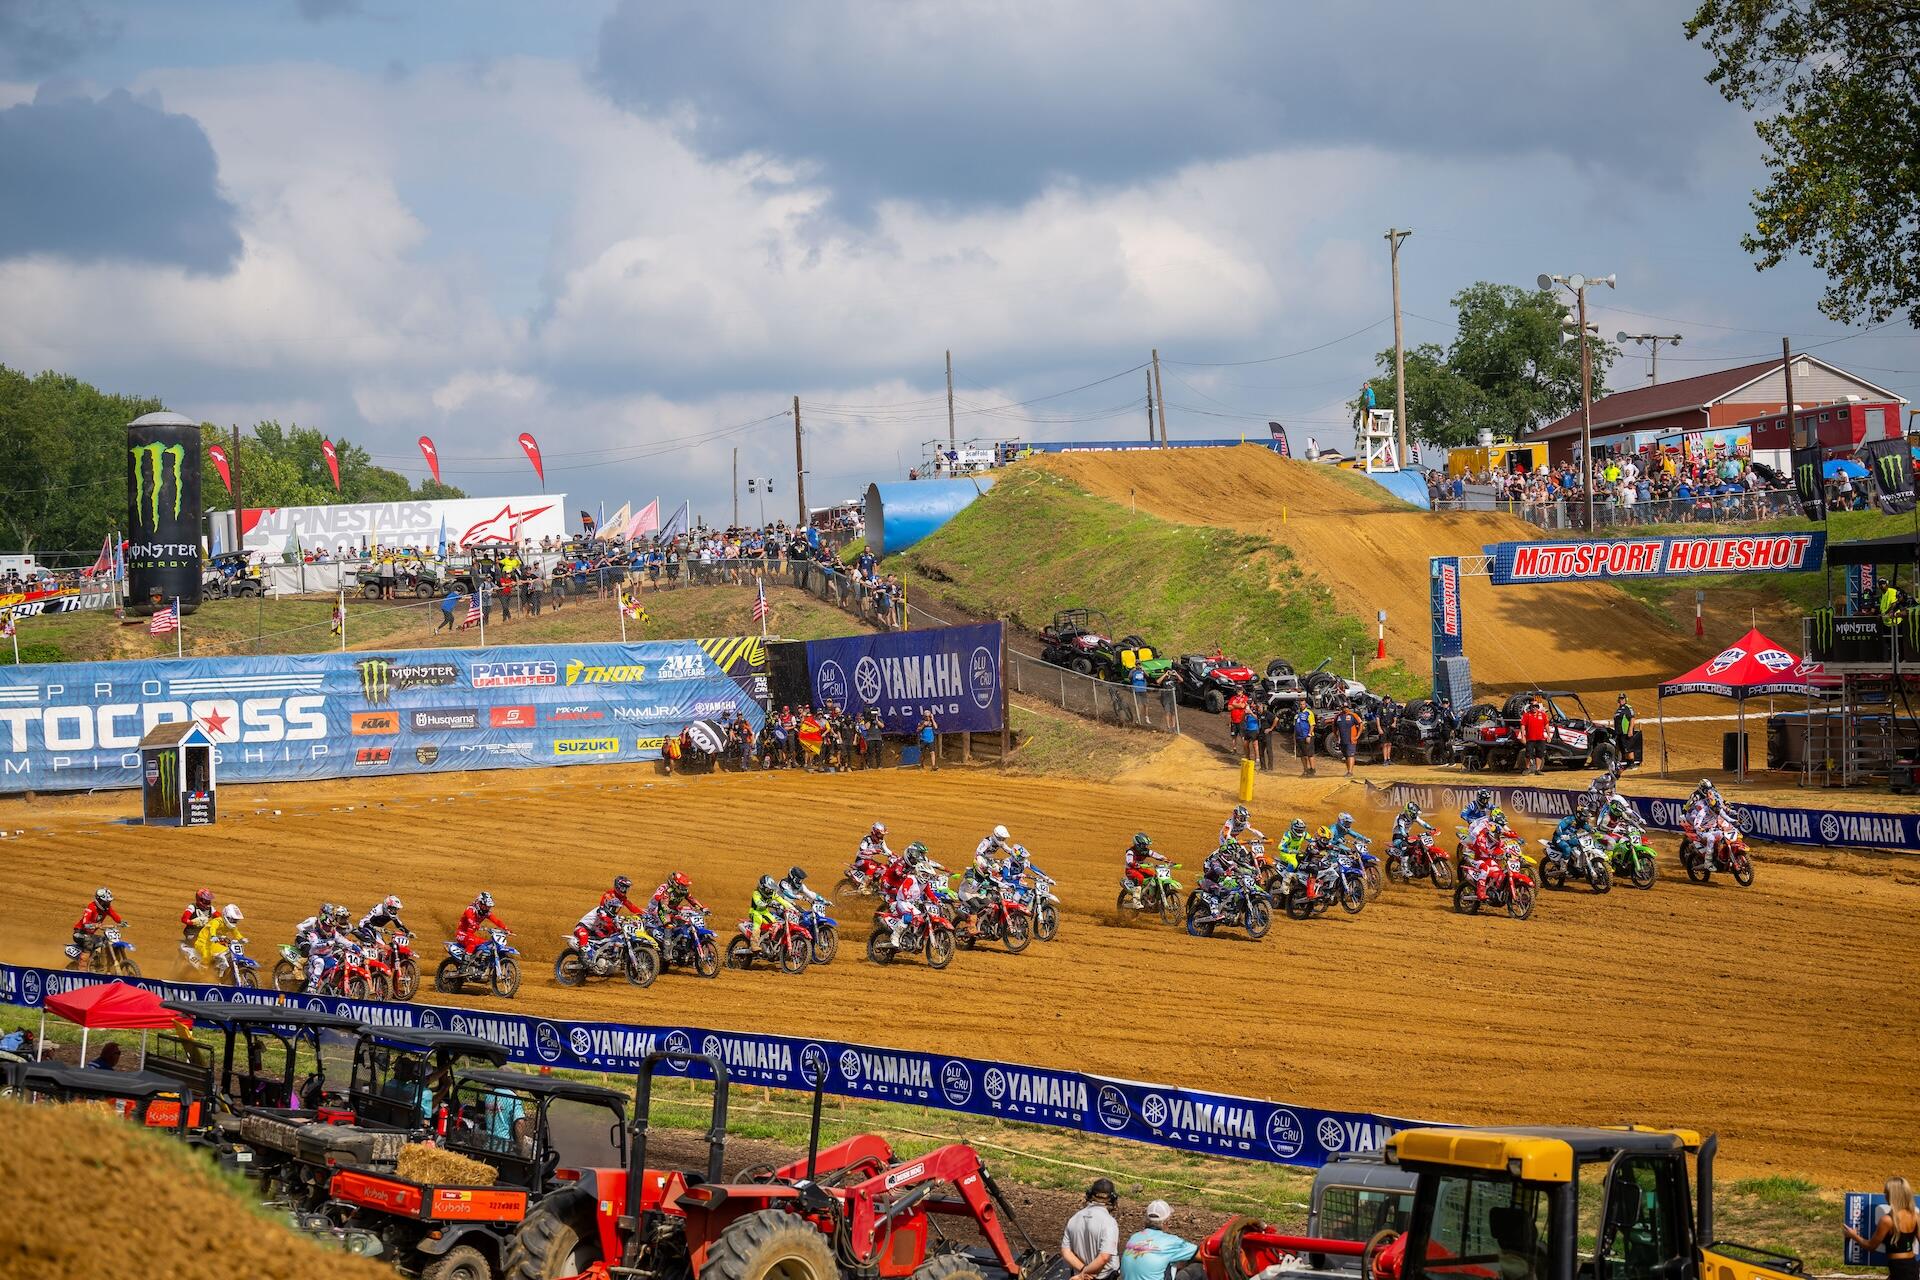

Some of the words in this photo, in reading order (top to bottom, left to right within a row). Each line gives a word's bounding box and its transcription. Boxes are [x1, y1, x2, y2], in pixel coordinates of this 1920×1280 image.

[256, 503, 433, 536] ALPINESTARS
[1667, 537, 1811, 572] HOLESHOT
[1836, 622, 1877, 633] MONSTER
[472, 662, 557, 679] PARTS
[658, 654, 704, 671] AMA
[392, 665, 455, 679] MONSTER
[584, 665, 646, 684] THOR
[659, 670, 673, 679] 100
[684, 668, 706, 677] YEARS
[880, 652, 964, 700] YAMAHA
[473, 675, 557, 687] UNLIMITED
[47, 680, 162, 700] PRO
[614, 704, 680, 718] NAMURA
[704, 700, 737, 712] YAMAHA
[361, 718, 391, 729] KTM
[427, 714, 474, 726] Husqvarna
[558, 740, 614, 752] SUZUKI
[1455, 789, 1501, 809] YAMHA
[1525, 791, 1574, 815] YAMAHA
[1751, 810, 1811, 838] YAMAHA
[1839, 815, 1906, 843] YAMAHA
[1727, 831, 1736, 840] 7
[467, 1017, 529, 1048] YAMAHA
[590, 1030, 656, 1058] YAMAHA
[579, 1056, 640, 1067] RACIN
[722, 1038, 793, 1072] YAMAHA
[710, 1067, 787, 1082] ACING
[861, 1053, 934, 1089] YAMAHA
[848, 1081, 929, 1099] RACING
[1007, 1072, 1088, 1112] YAMAHA
[150, 1111, 178, 1121] Kubot
[992, 1100, 1082, 1121] RACING
[1168, 1098, 1257, 1140] YAMAHA
[1152, 1127, 1251, 1150] RACING
[1345, 1121, 1392, 1152] YAM
[364, 1187, 389, 1201] Kubota
[434, 1202, 471, 1213] Kubota
